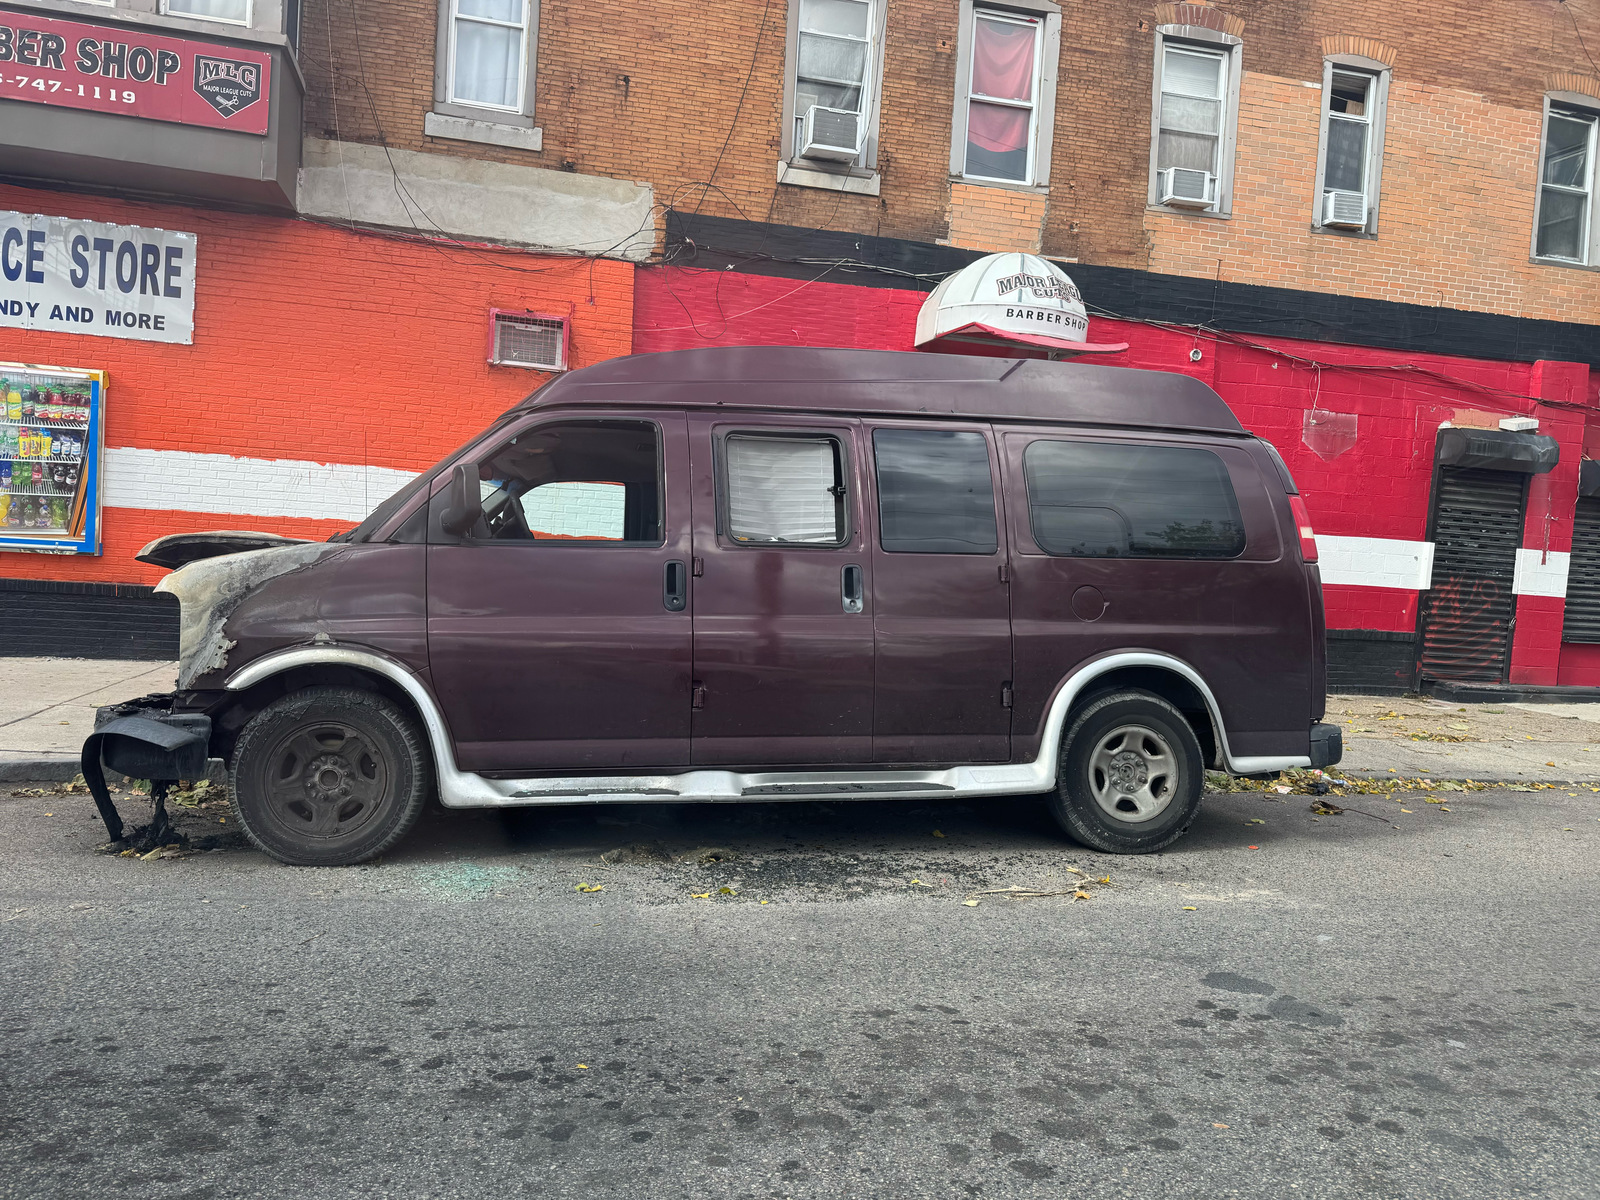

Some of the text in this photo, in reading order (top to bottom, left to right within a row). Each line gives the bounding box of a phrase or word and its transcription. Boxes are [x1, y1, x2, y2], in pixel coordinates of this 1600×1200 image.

[0, 25, 180, 85] BER SHOP
[0, 73, 136, 103] -747-1119
[198, 59, 256, 91] MLC
[203, 84, 219, 92] MAJOR
[220, 86, 239, 95] LEAGUE
[2, 227, 183, 298] CE STORE
[997, 273, 1046, 296] MAJOR
[49, 304, 94, 323] AND
[105, 310, 165, 331] MORE
[1006, 308, 1086, 331] BARBER SHOP
